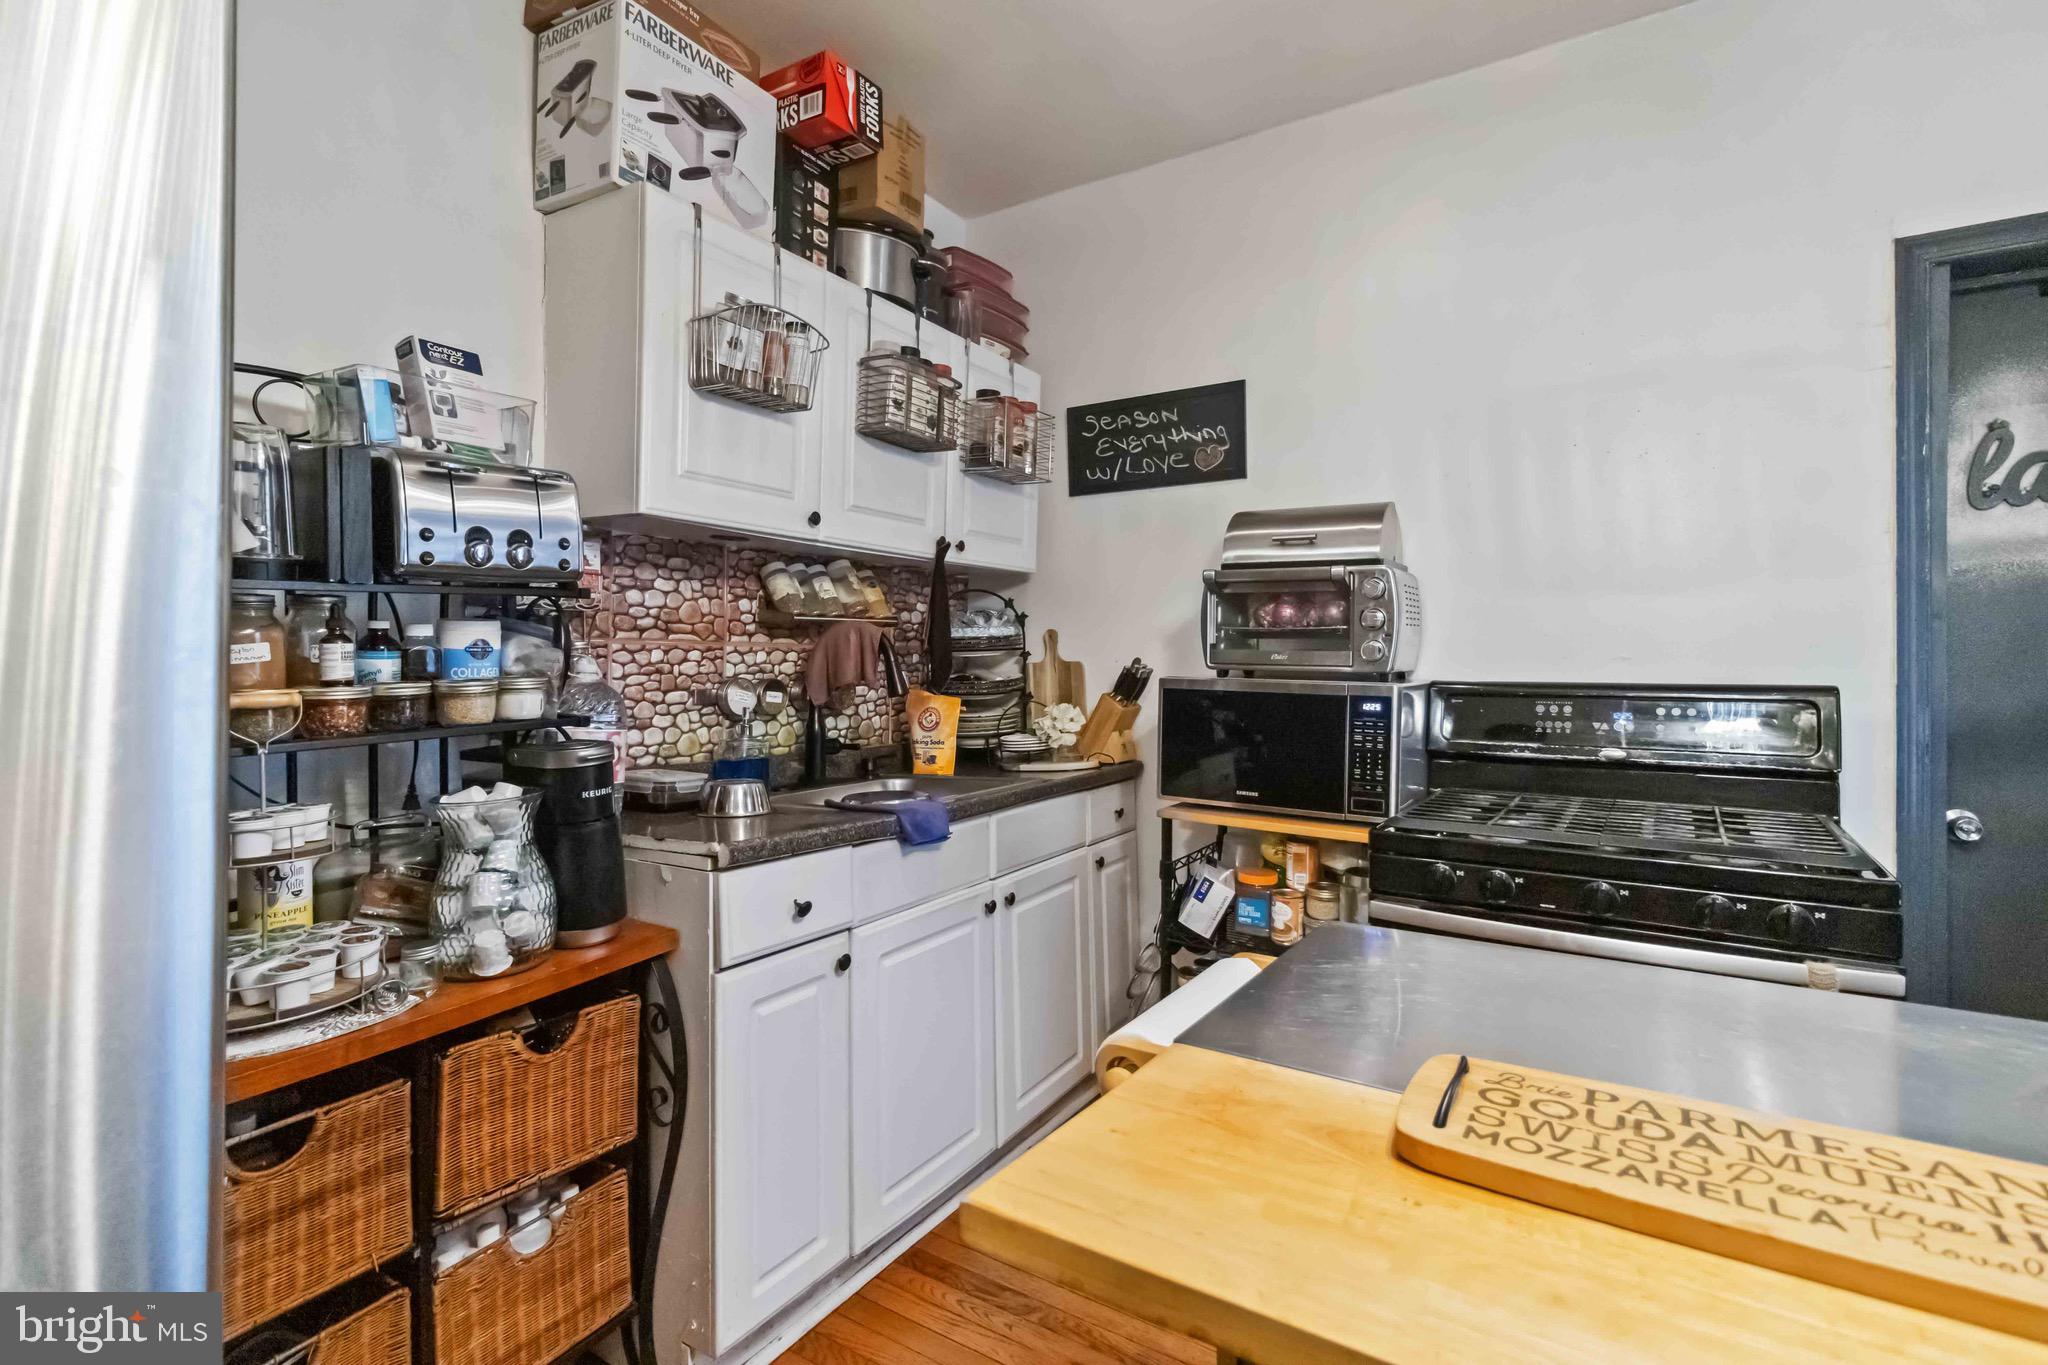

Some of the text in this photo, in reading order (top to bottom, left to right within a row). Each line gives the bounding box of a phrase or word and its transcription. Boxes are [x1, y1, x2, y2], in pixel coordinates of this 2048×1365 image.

[540, 2, 615, 54] FARBERWARE
[625, 1, 734, 88] FARBERWARE
[625, 29, 692, 75] 4-LITER DEEP FRYER
[865, 82, 879, 143] FORKS
[426, 342, 463, 357] Contour
[428, 350, 449, 360] next
[449, 356, 465, 367] EZ
[582, 786, 613, 798] KEURIG
[1468, 1105, 1713, 1178] SWISS
[1477, 1087, 1724, 1156] GOUDA
[1484, 1072, 2048, 1197] Brie PARMESAN
[1462, 1125, 1849, 1233] MOZZARELLA
